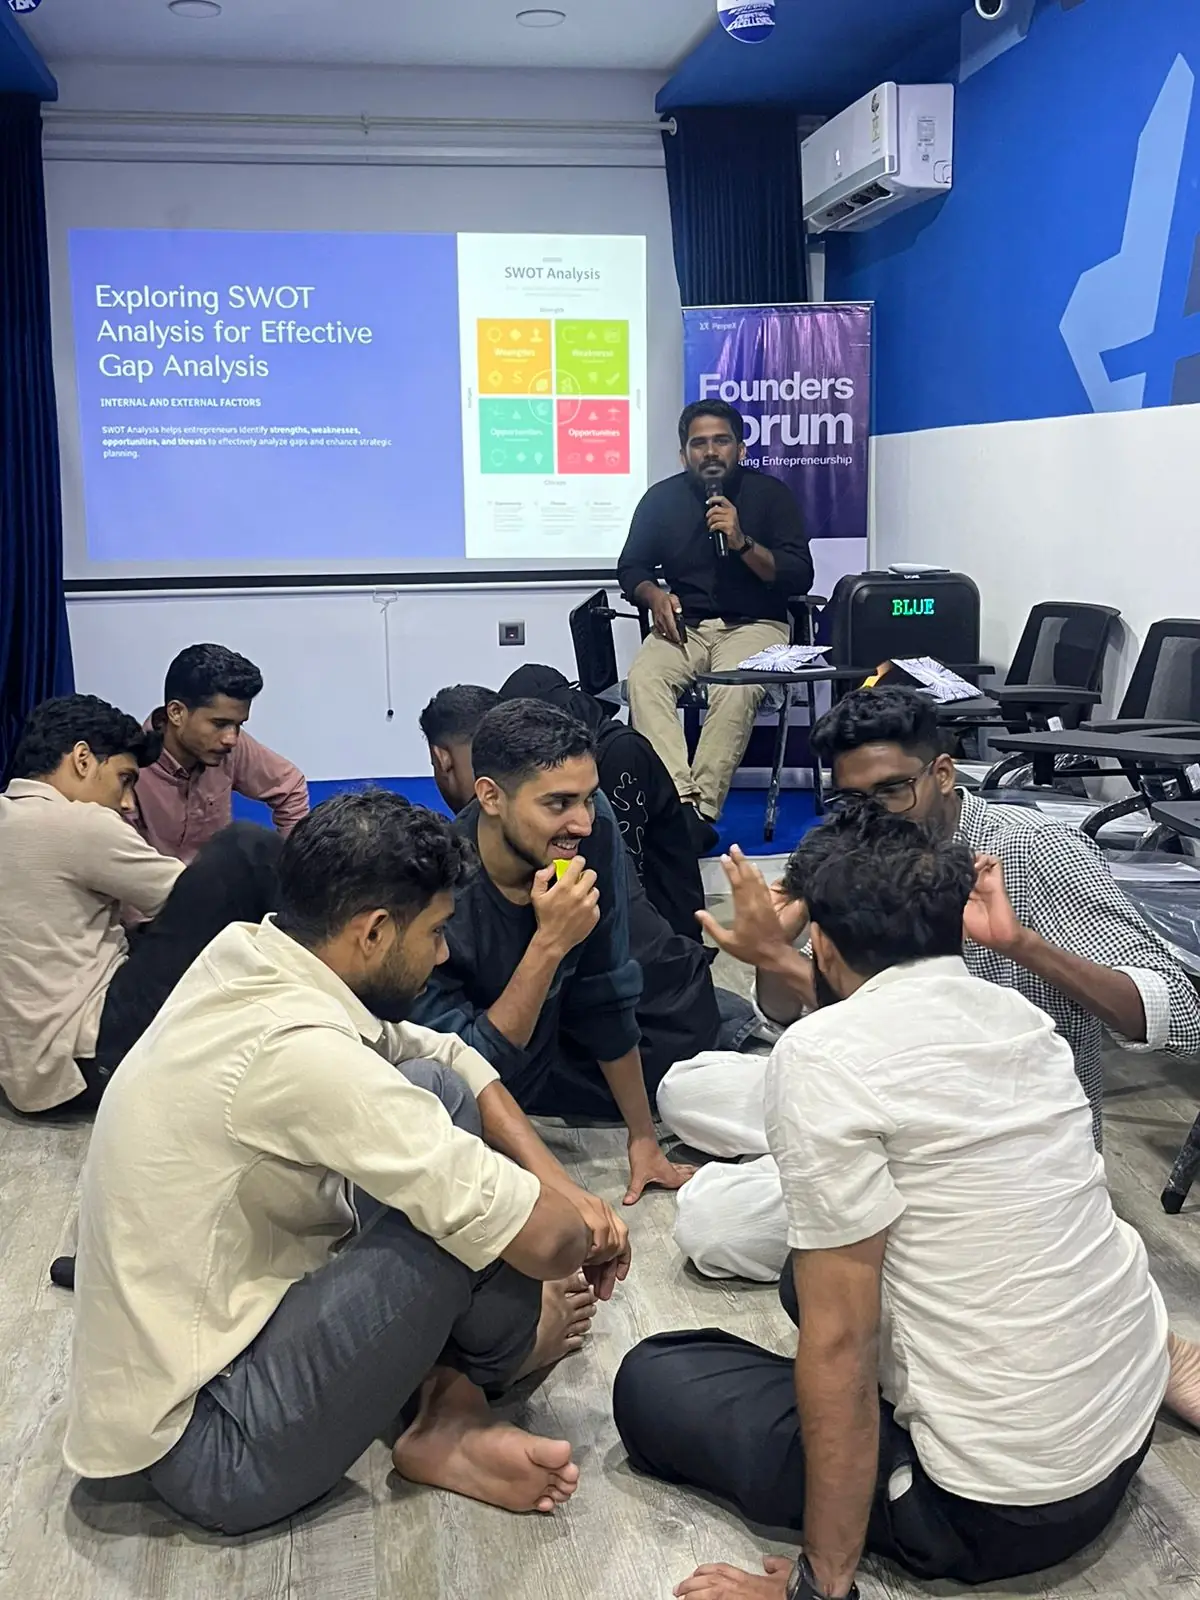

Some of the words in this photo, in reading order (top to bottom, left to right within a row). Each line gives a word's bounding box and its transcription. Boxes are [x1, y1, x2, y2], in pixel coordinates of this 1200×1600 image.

[504, 266, 544, 279] SWOT
[546, 268, 601, 283] Analysis
[95, 284, 219, 315] Exploring
[228, 285, 315, 309] SWOT
[97, 319, 205, 349] Analysis
[213, 319, 251, 343] for
[261, 320, 373, 344] Effective
[98, 353, 154, 383] Gap
[162, 354, 270, 383] Analysis
[700, 371, 854, 402] Founders
[100, 398, 148, 408] INTERNAL
[149, 398, 170, 408] AND
[171, 398, 219, 408] EXTERNAL
[220, 398, 262, 408] FACTORS
[102, 426, 126, 435] SWOT
[126, 426, 160, 436] Analysis
[161, 426, 182, 436] helps
[183, 426, 238, 436] entrepreneurs
[239, 426, 269, 436] identify
[269, 426, 310, 437] strengths,
[311, 426, 362, 435] weaknesses,
[742, 412, 854, 447] orum
[102, 438, 160, 448] opportunities,
[161, 438, 177, 446] and
[178, 438, 207, 446] threats
[208, 438, 217, 446] to
[218, 438, 257, 448] effectively
[258, 438, 288, 448] analyze
[289, 439, 309, 448] gaps
[310, 438, 325, 447] and
[326, 438, 358, 447] enhance
[359, 438, 393, 448] strategic
[103, 450, 140, 460] planning.
[762, 454, 853, 468] Entrepreneurship
[892, 598, 935, 616] BLUE
